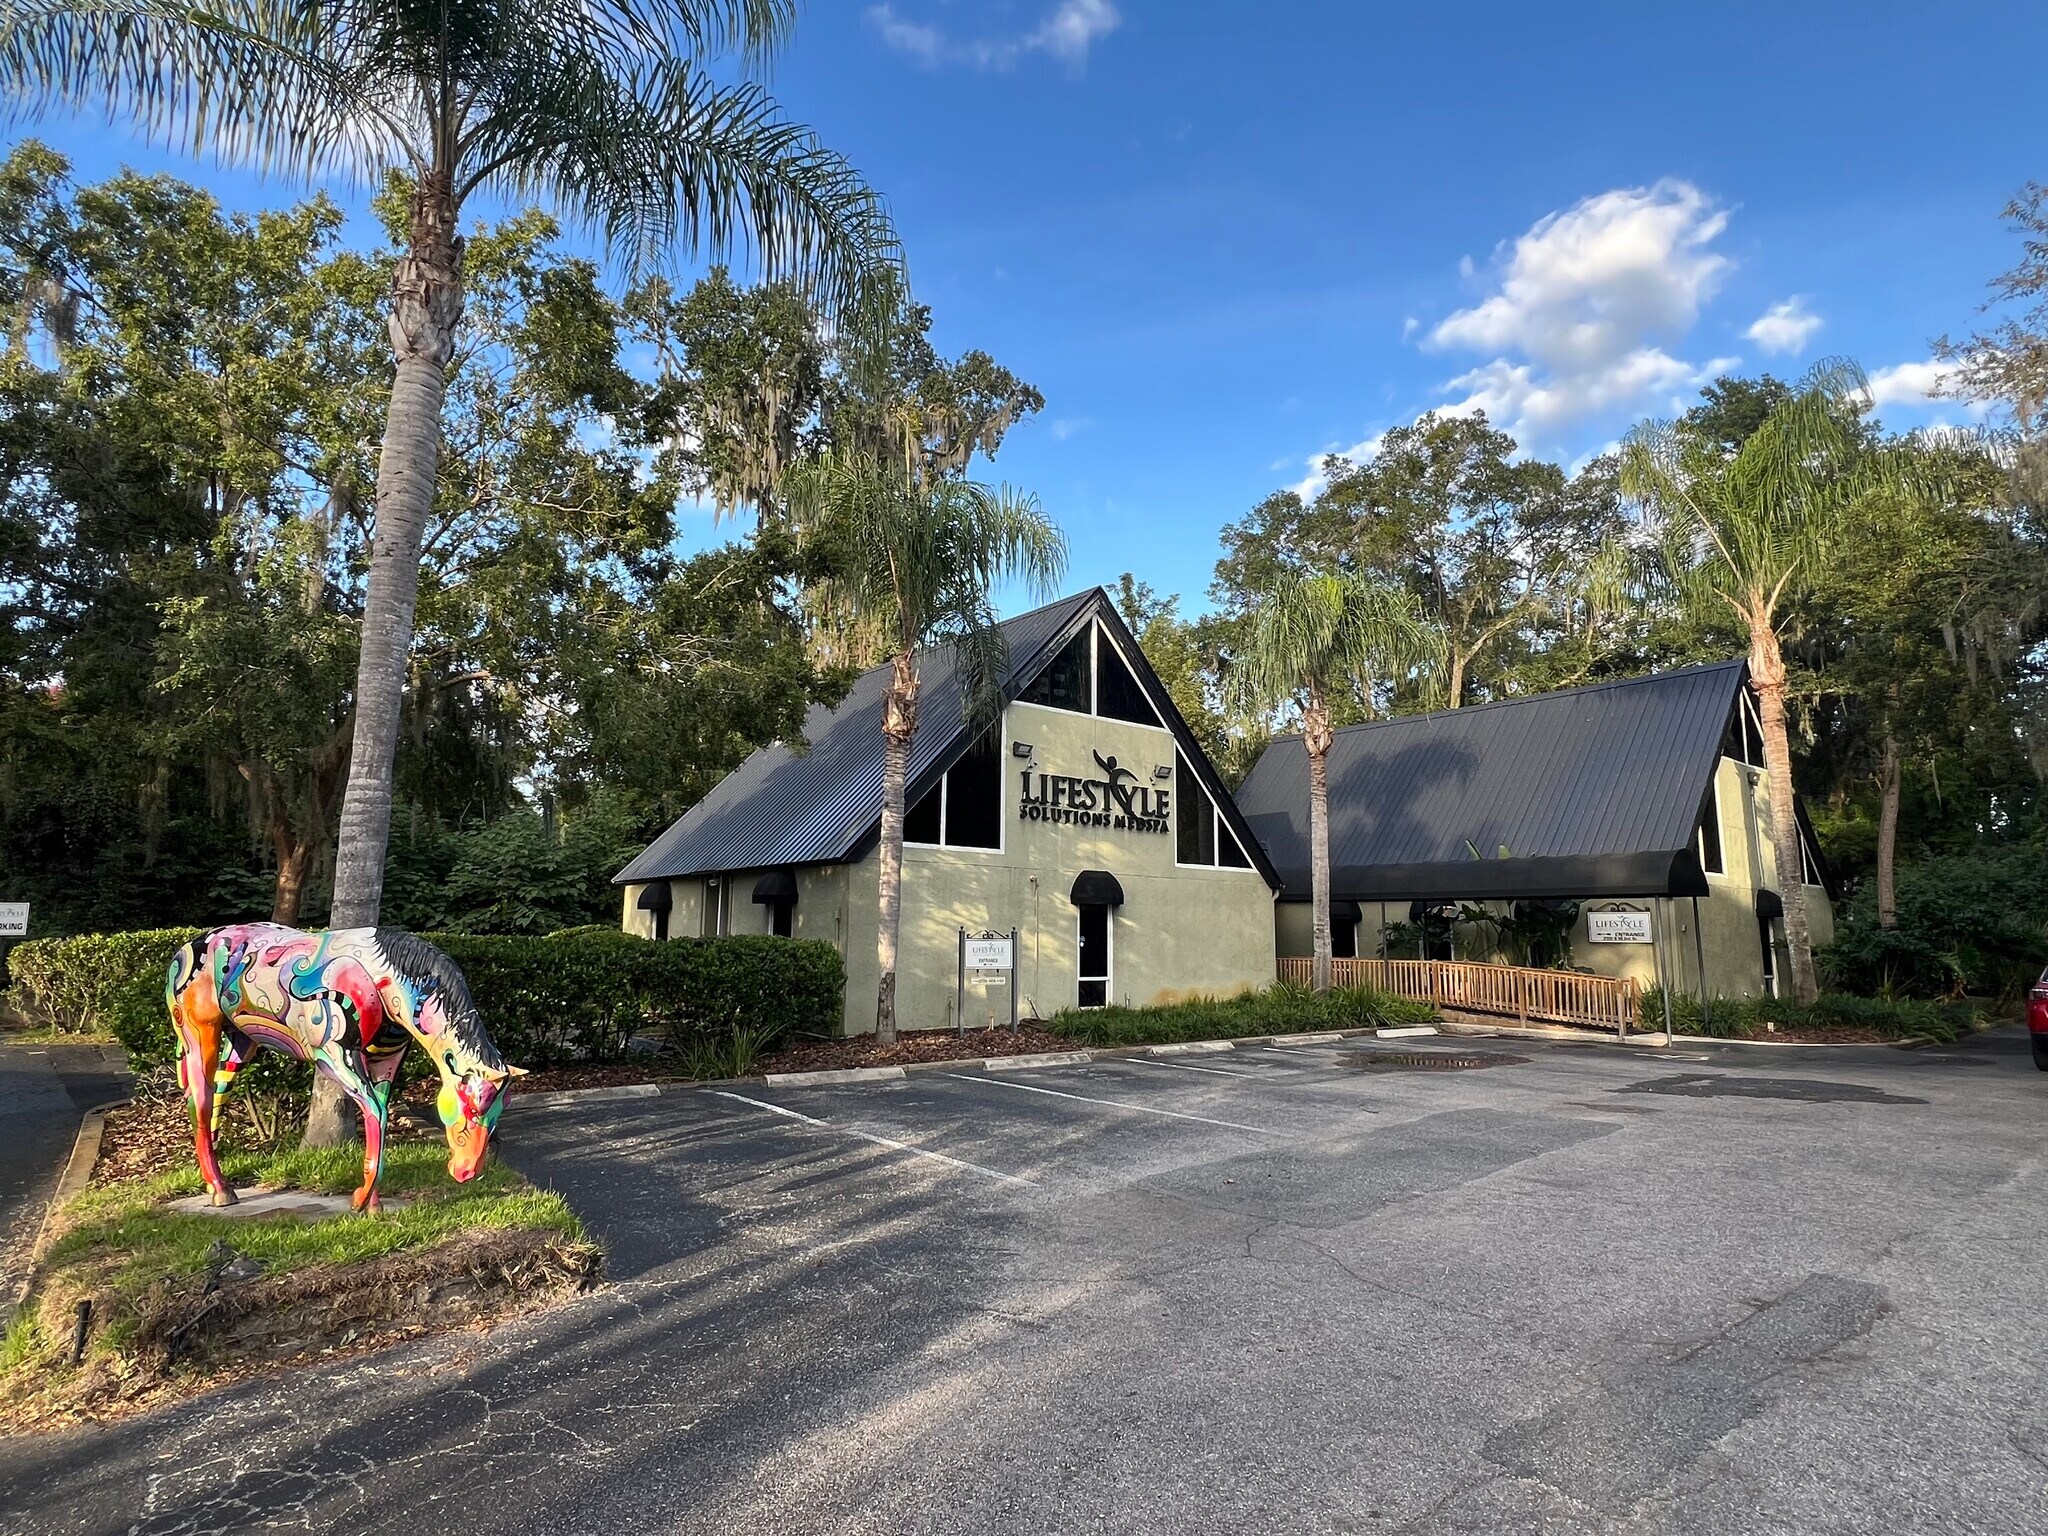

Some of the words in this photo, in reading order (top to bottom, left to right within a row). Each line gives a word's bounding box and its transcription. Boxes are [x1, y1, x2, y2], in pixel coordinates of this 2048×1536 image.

[1020, 769, 1170, 819] LIFESTYLE
[1019, 804, 1111, 827] SOLUTIONS
[1113, 814, 1170, 834] MEDSPA
[1595, 918, 1644, 928] LIFESTYLE
[972, 945, 1005, 954] LIFESTYLE
